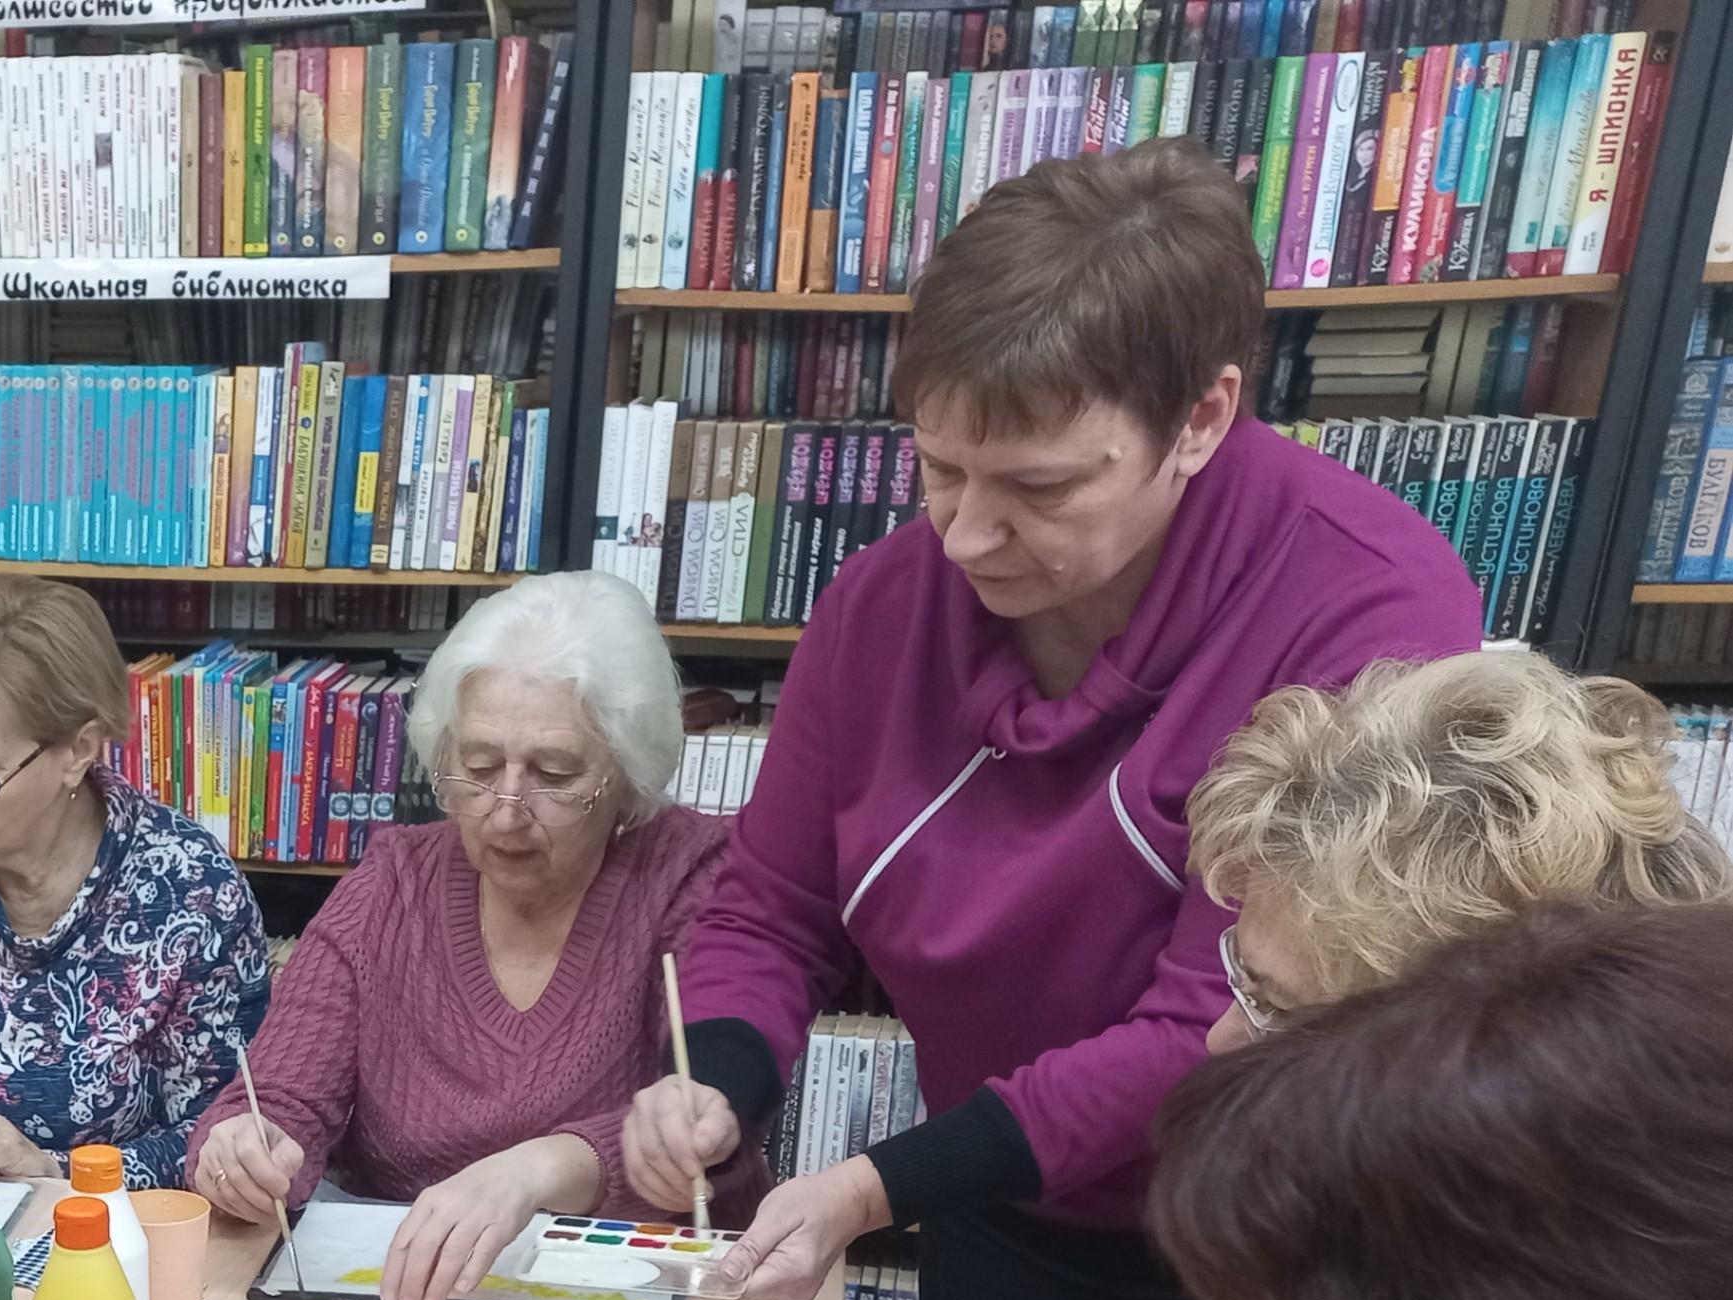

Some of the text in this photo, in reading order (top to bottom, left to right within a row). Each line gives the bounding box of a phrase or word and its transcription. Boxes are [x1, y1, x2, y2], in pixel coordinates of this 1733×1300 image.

[1595, 47, 1638, 165] ШПИОНКА
[1401, 126, 1437, 252] КУЛИКОВА
[1588, 189, 1607, 203] Я
[3, 270, 348, 299] Школьная библиотека
[291, 435, 309, 534] БАБУШКИНА МАГИЯ
[732, 504, 750, 557] СТИЛ
[1475, 477, 1514, 575] УСТИНОВА
[1509, 476, 1548, 575] УСТИНОВА
[1546, 474, 1578, 560] ЛЕБЕДЕВА
[1689, 457, 1727, 549] БУЛГАКОВ
